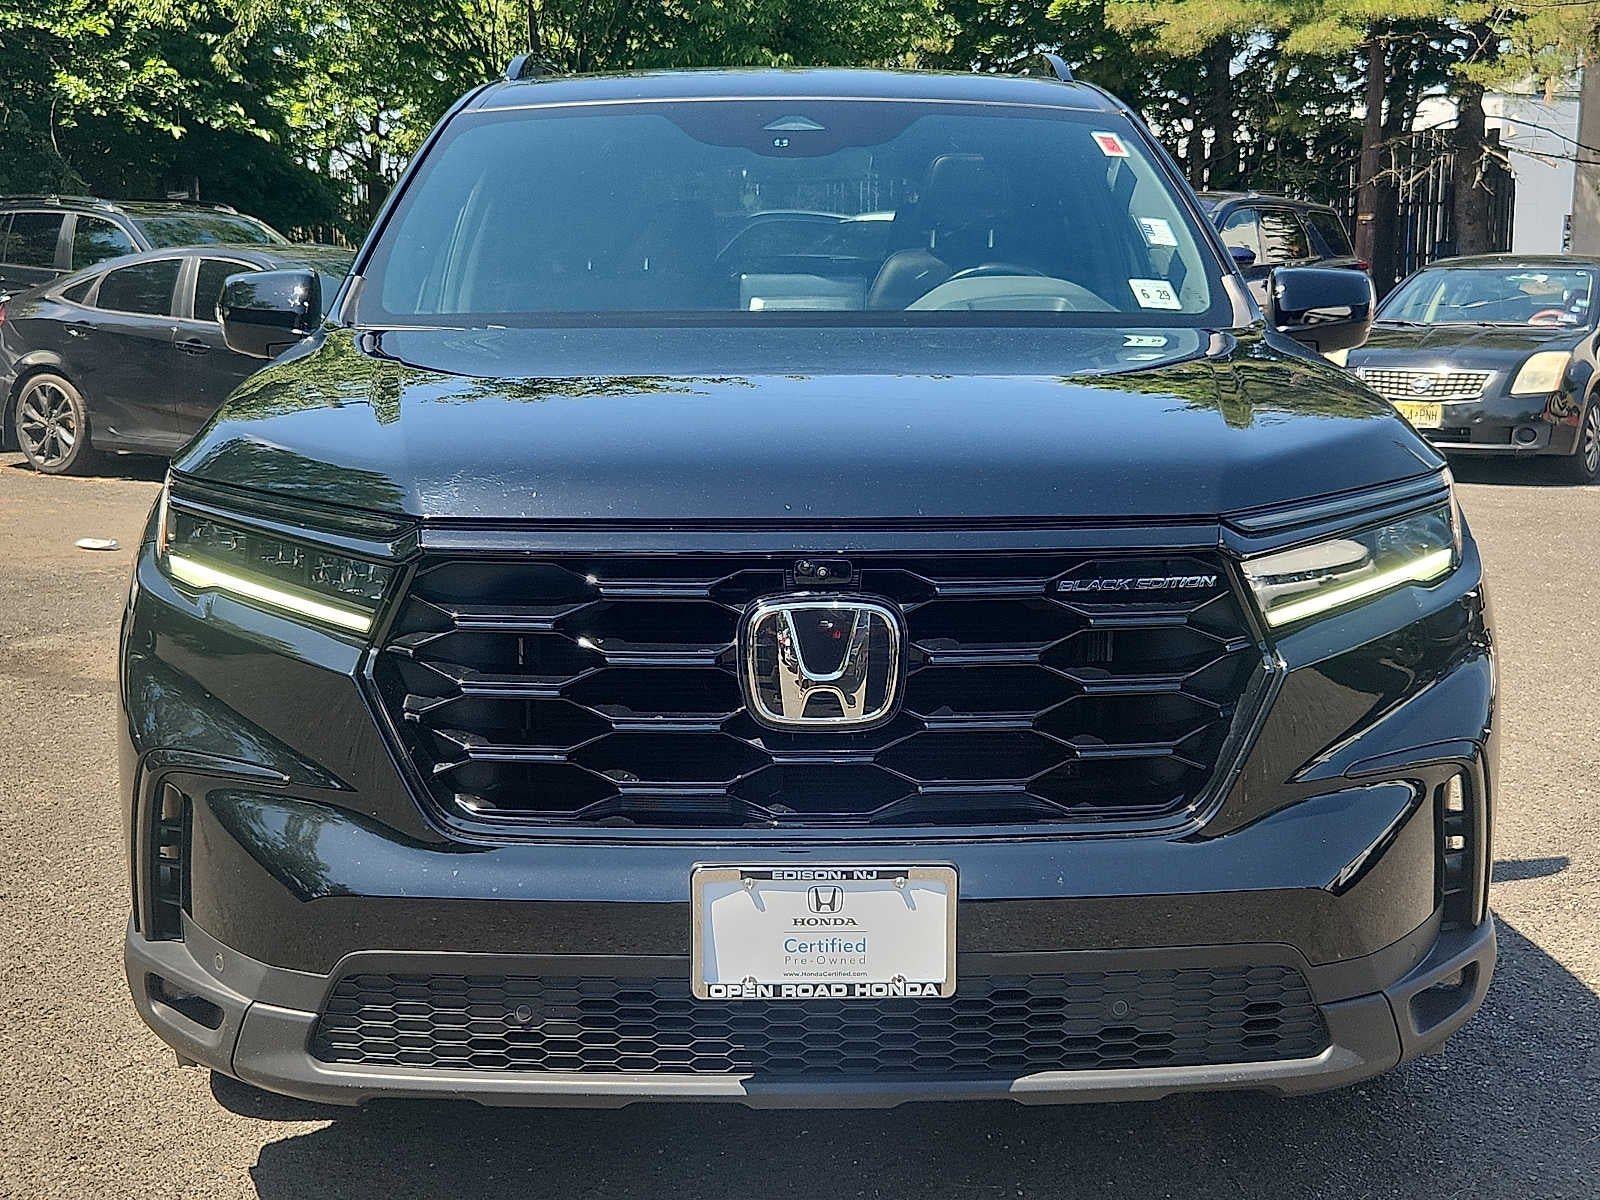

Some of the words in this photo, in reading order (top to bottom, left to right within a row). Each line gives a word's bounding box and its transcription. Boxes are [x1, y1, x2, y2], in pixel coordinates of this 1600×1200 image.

[1057, 578, 1132, 592] BLACK
[1134, 575, 1218, 590] EDITION
[771, 870, 847, 880] EDISON,
[853, 870, 878, 880] NJ
[792, 917, 859, 927] HONDA
[784, 937, 867, 953] Certified
[784, 955, 867, 965] Pre-Owned
[709, 983, 774, 998] OPEN
[781, 983, 848, 998] ROAD
[854, 982, 940, 997] HONDA
